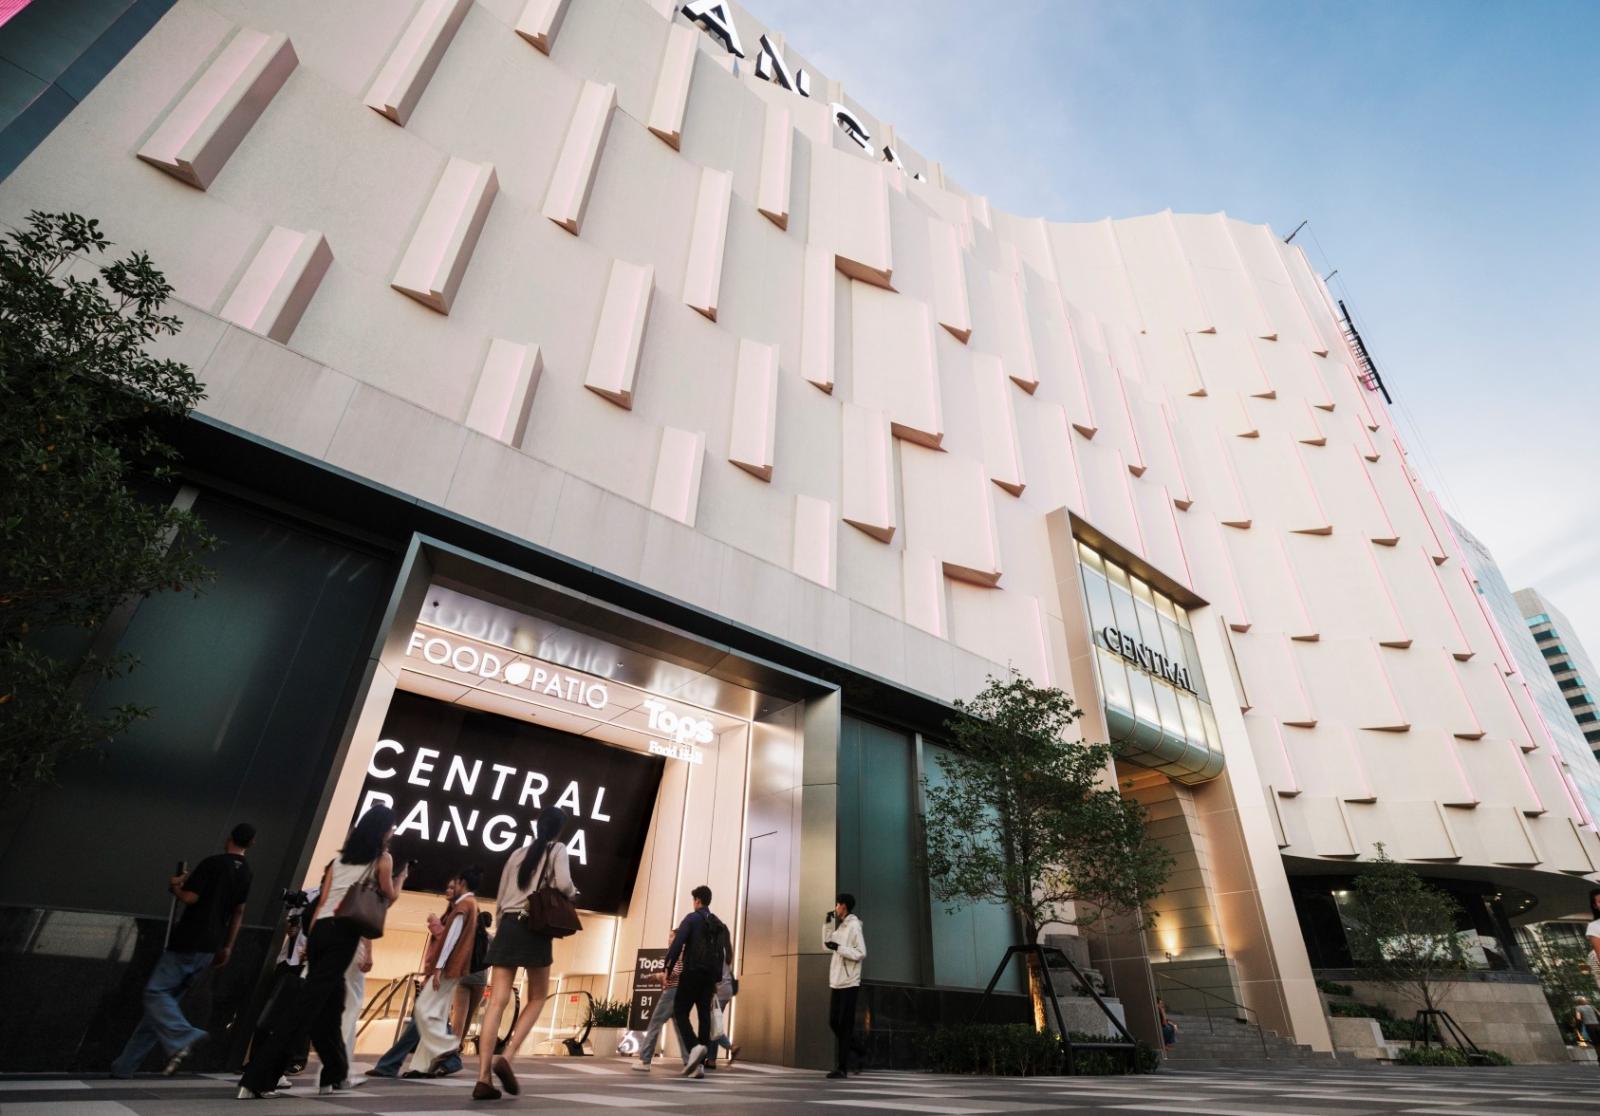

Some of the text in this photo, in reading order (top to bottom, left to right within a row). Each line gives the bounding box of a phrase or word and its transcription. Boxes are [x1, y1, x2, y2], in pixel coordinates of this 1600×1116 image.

[404, 631, 609, 710] FOOD PATIO
[1102, 626, 1198, 696] CENTRAL
[643, 699, 715, 744] Tops
[367, 739, 612, 823] CENTRAL
[638, 957, 666, 972] Tops
[640, 995, 653, 1007] B1
